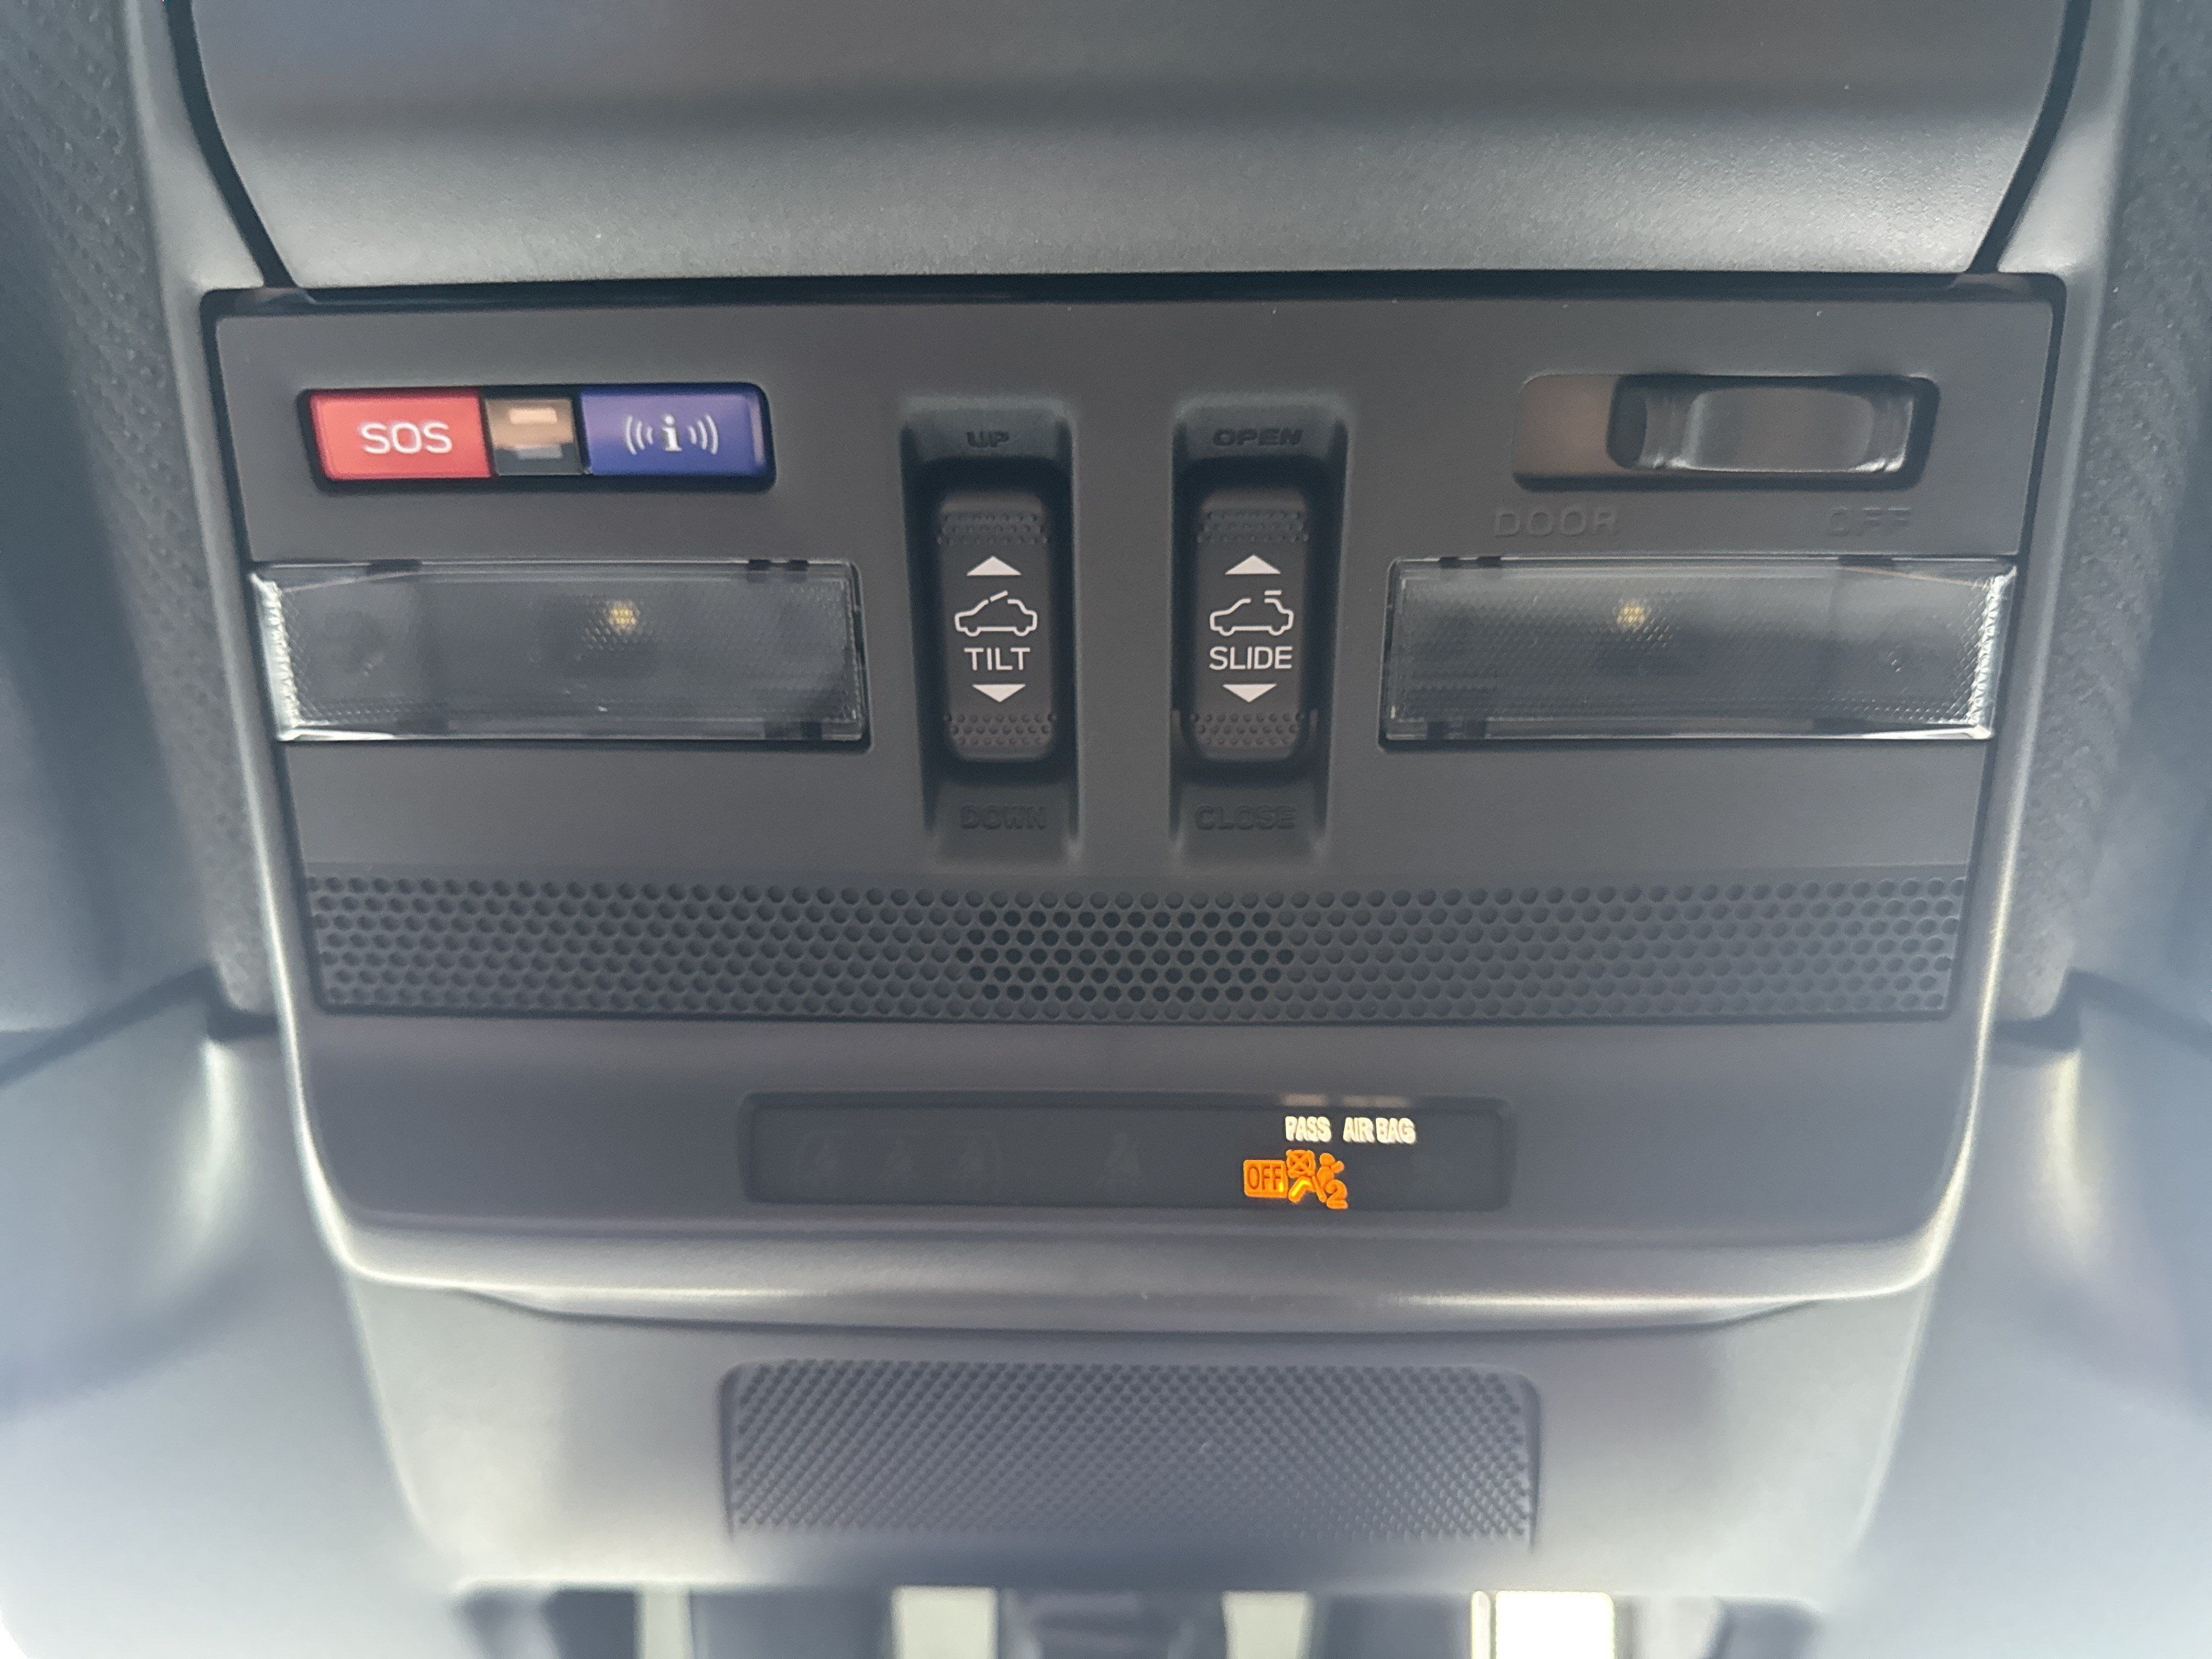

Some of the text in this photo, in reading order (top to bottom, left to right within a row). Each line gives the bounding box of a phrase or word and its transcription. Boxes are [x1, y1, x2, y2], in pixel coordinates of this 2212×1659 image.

[359, 421, 453, 455] SOS
[965, 430, 1011, 448] UP
[1212, 428, 1304, 447] OPEN
[1493, 505, 1618, 537] DOOR
[1827, 506, 1912, 537] OFF
[964, 647, 1031, 670] TILT
[1209, 646, 1293, 670] SLIDE
[960, 805, 1047, 830] DOWN
[1194, 805, 1297, 831] CLOSE
[1285, 1116, 1332, 1142] PASS
[1246, 1164, 1282, 1190] OFF
